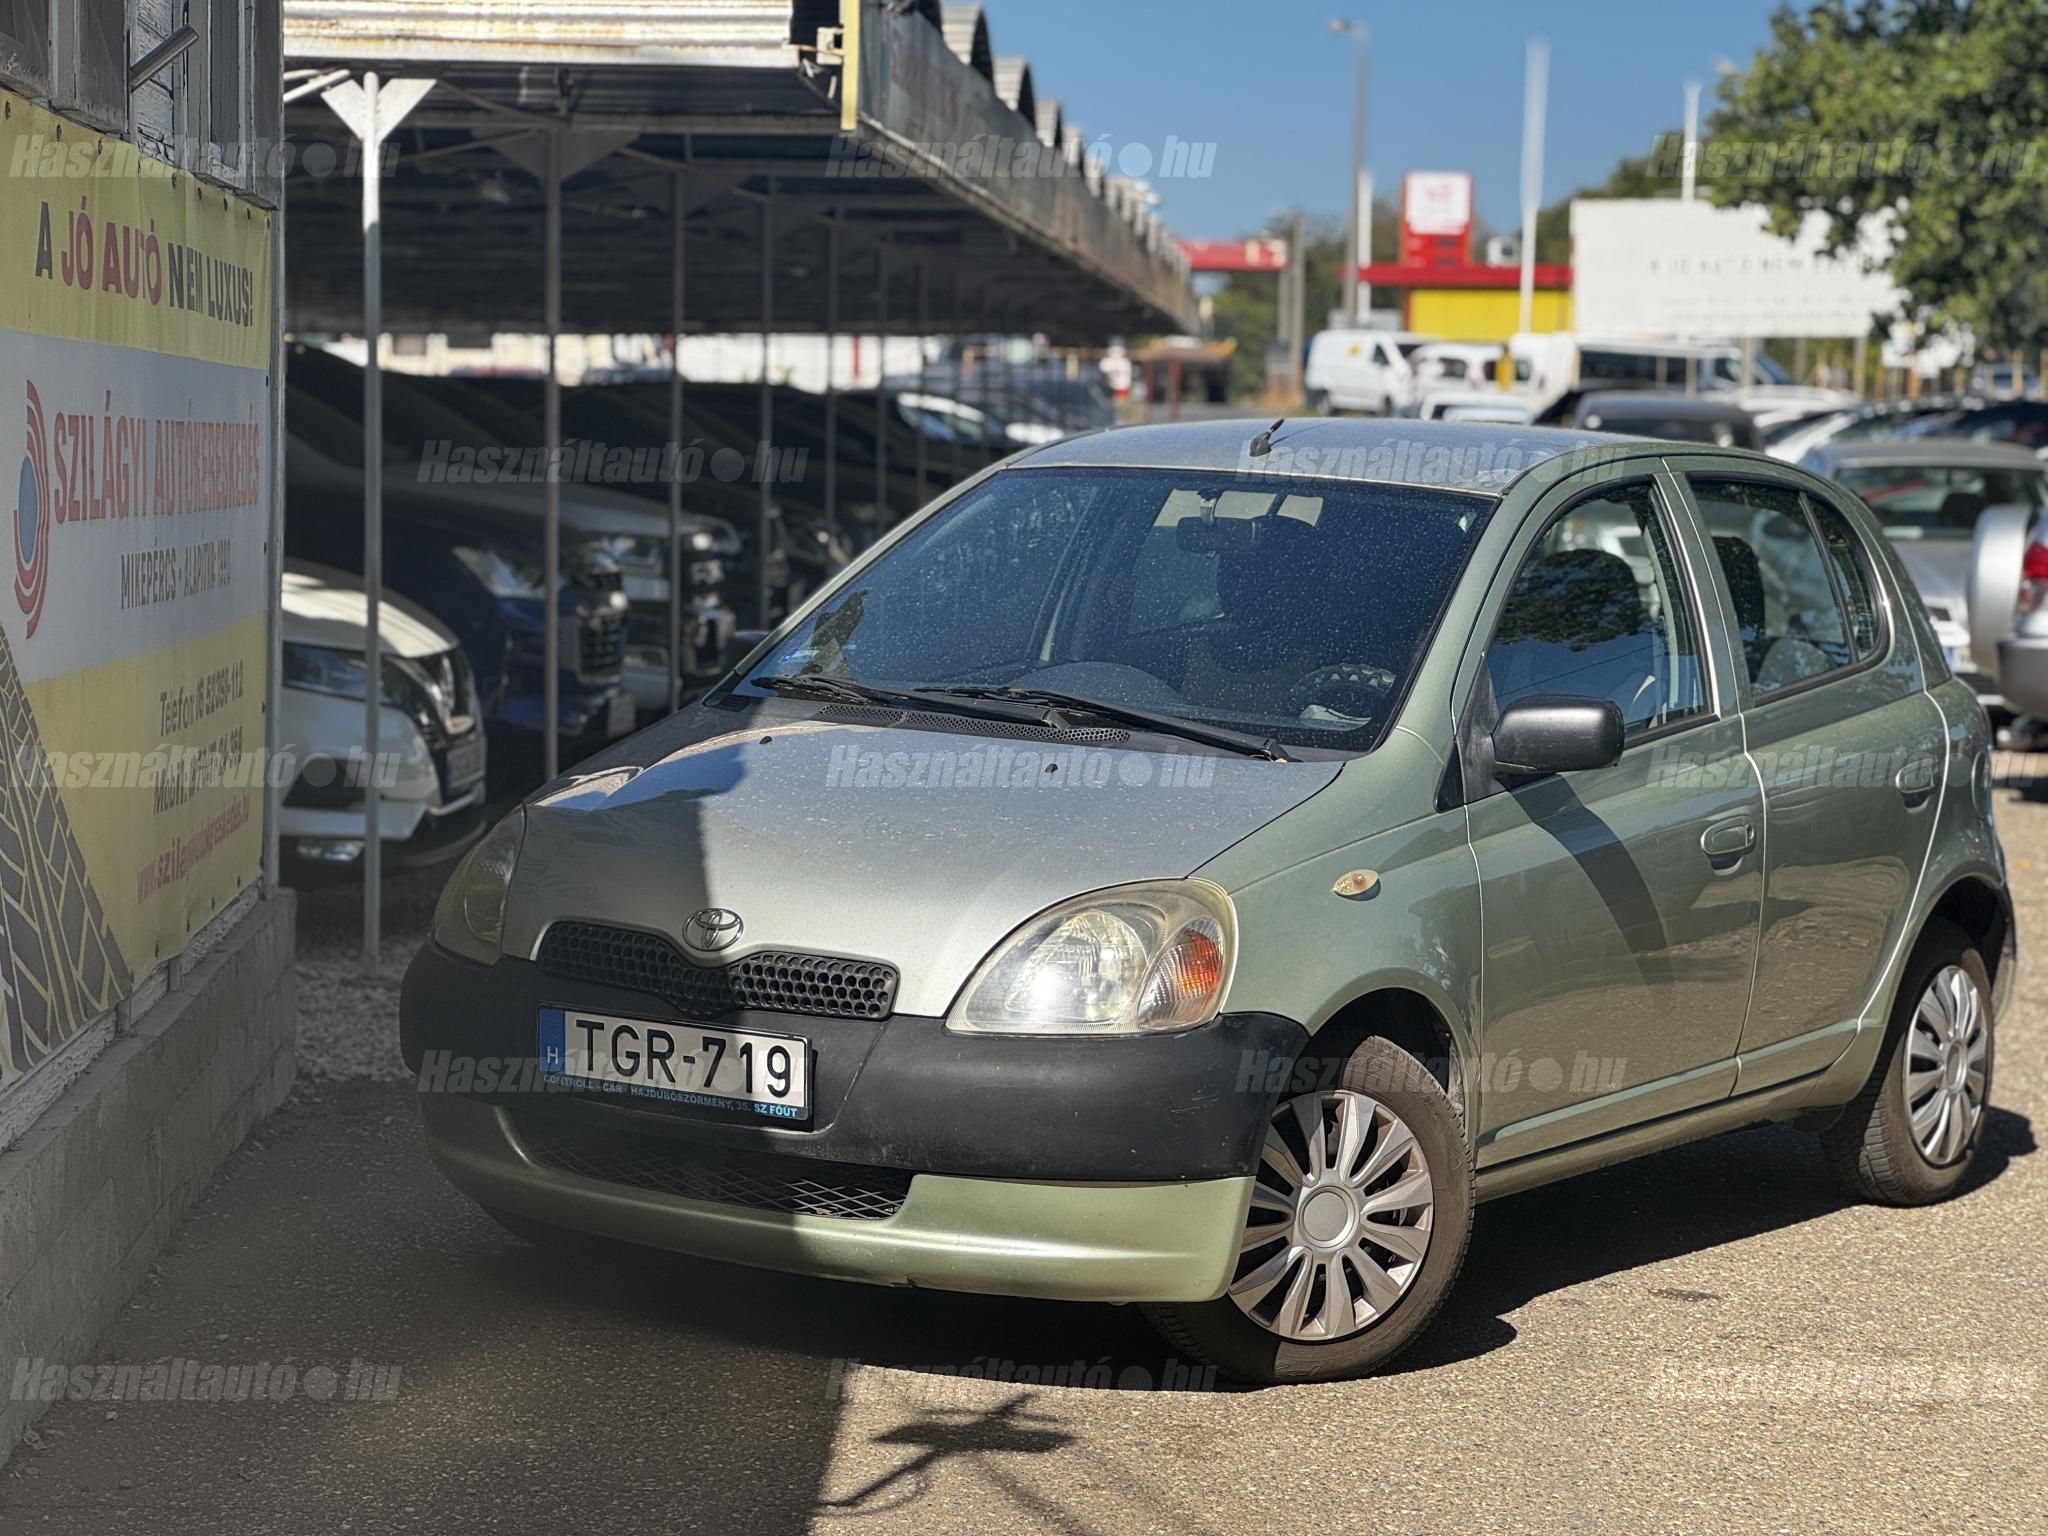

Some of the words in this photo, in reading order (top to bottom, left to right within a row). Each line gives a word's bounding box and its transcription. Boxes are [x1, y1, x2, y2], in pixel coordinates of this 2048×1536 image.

[35, 201, 53, 280] A
[61, 196, 94, 290] JÓ
[102, 218, 162, 305] AUTÓ
[168, 242, 203, 313] NEM
[207, 256, 253, 327] LUXUS!
[54, 390, 147, 524] SZILÁGYI
[121, 536, 176, 610] MIKEPÉRCS
[546, 1046, 559, 1065] H
[576, 1019, 791, 1098] TGR-719
[544, 1074, 594, 1092] CONTROLL
[602, 1082, 623, 1094] CAR
[754, 1103, 769, 1114] SZ
